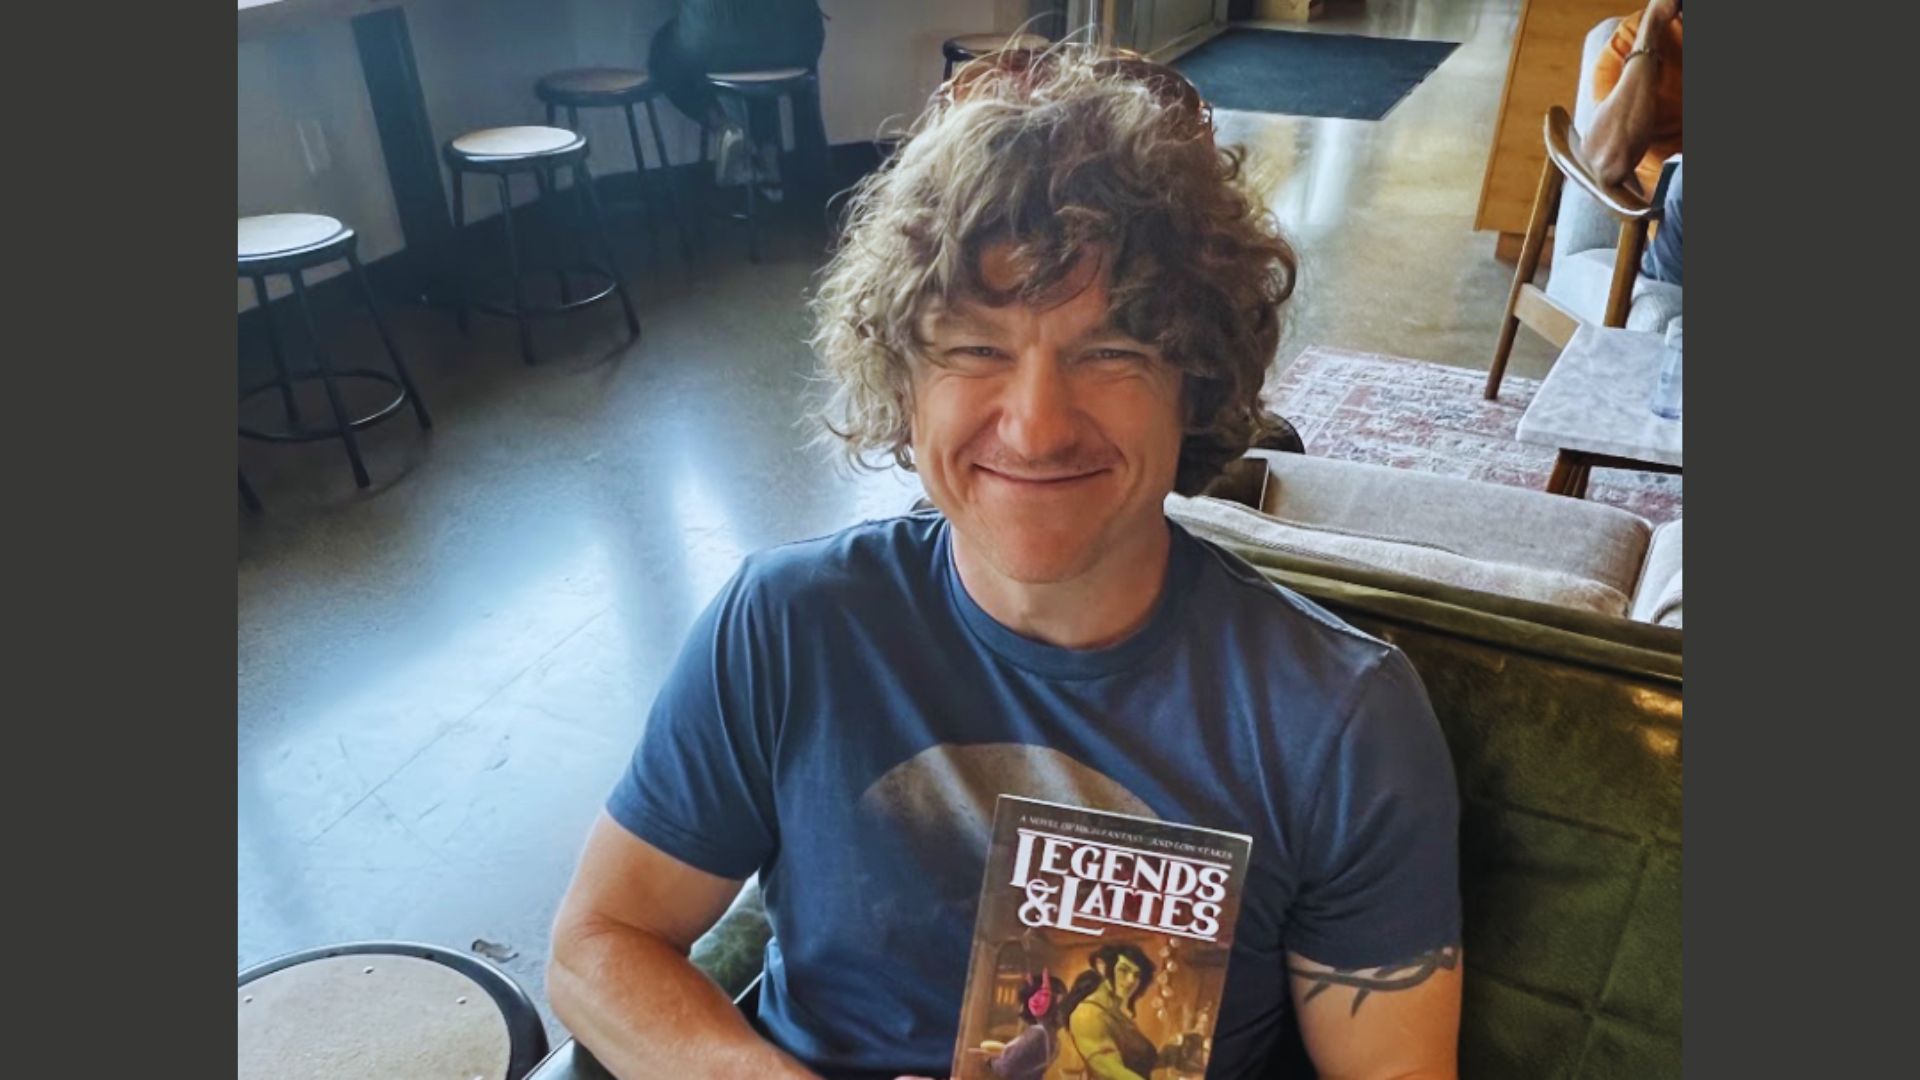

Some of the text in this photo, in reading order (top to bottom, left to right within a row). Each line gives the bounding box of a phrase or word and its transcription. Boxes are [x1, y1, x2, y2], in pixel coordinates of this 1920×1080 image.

[1029, 817, 1058, 829] NOVEL
[1060, 822, 1073, 831] OF
[1010, 834, 1229, 903] LEGENDS
[1018, 875, 1223, 936] & LATTES
